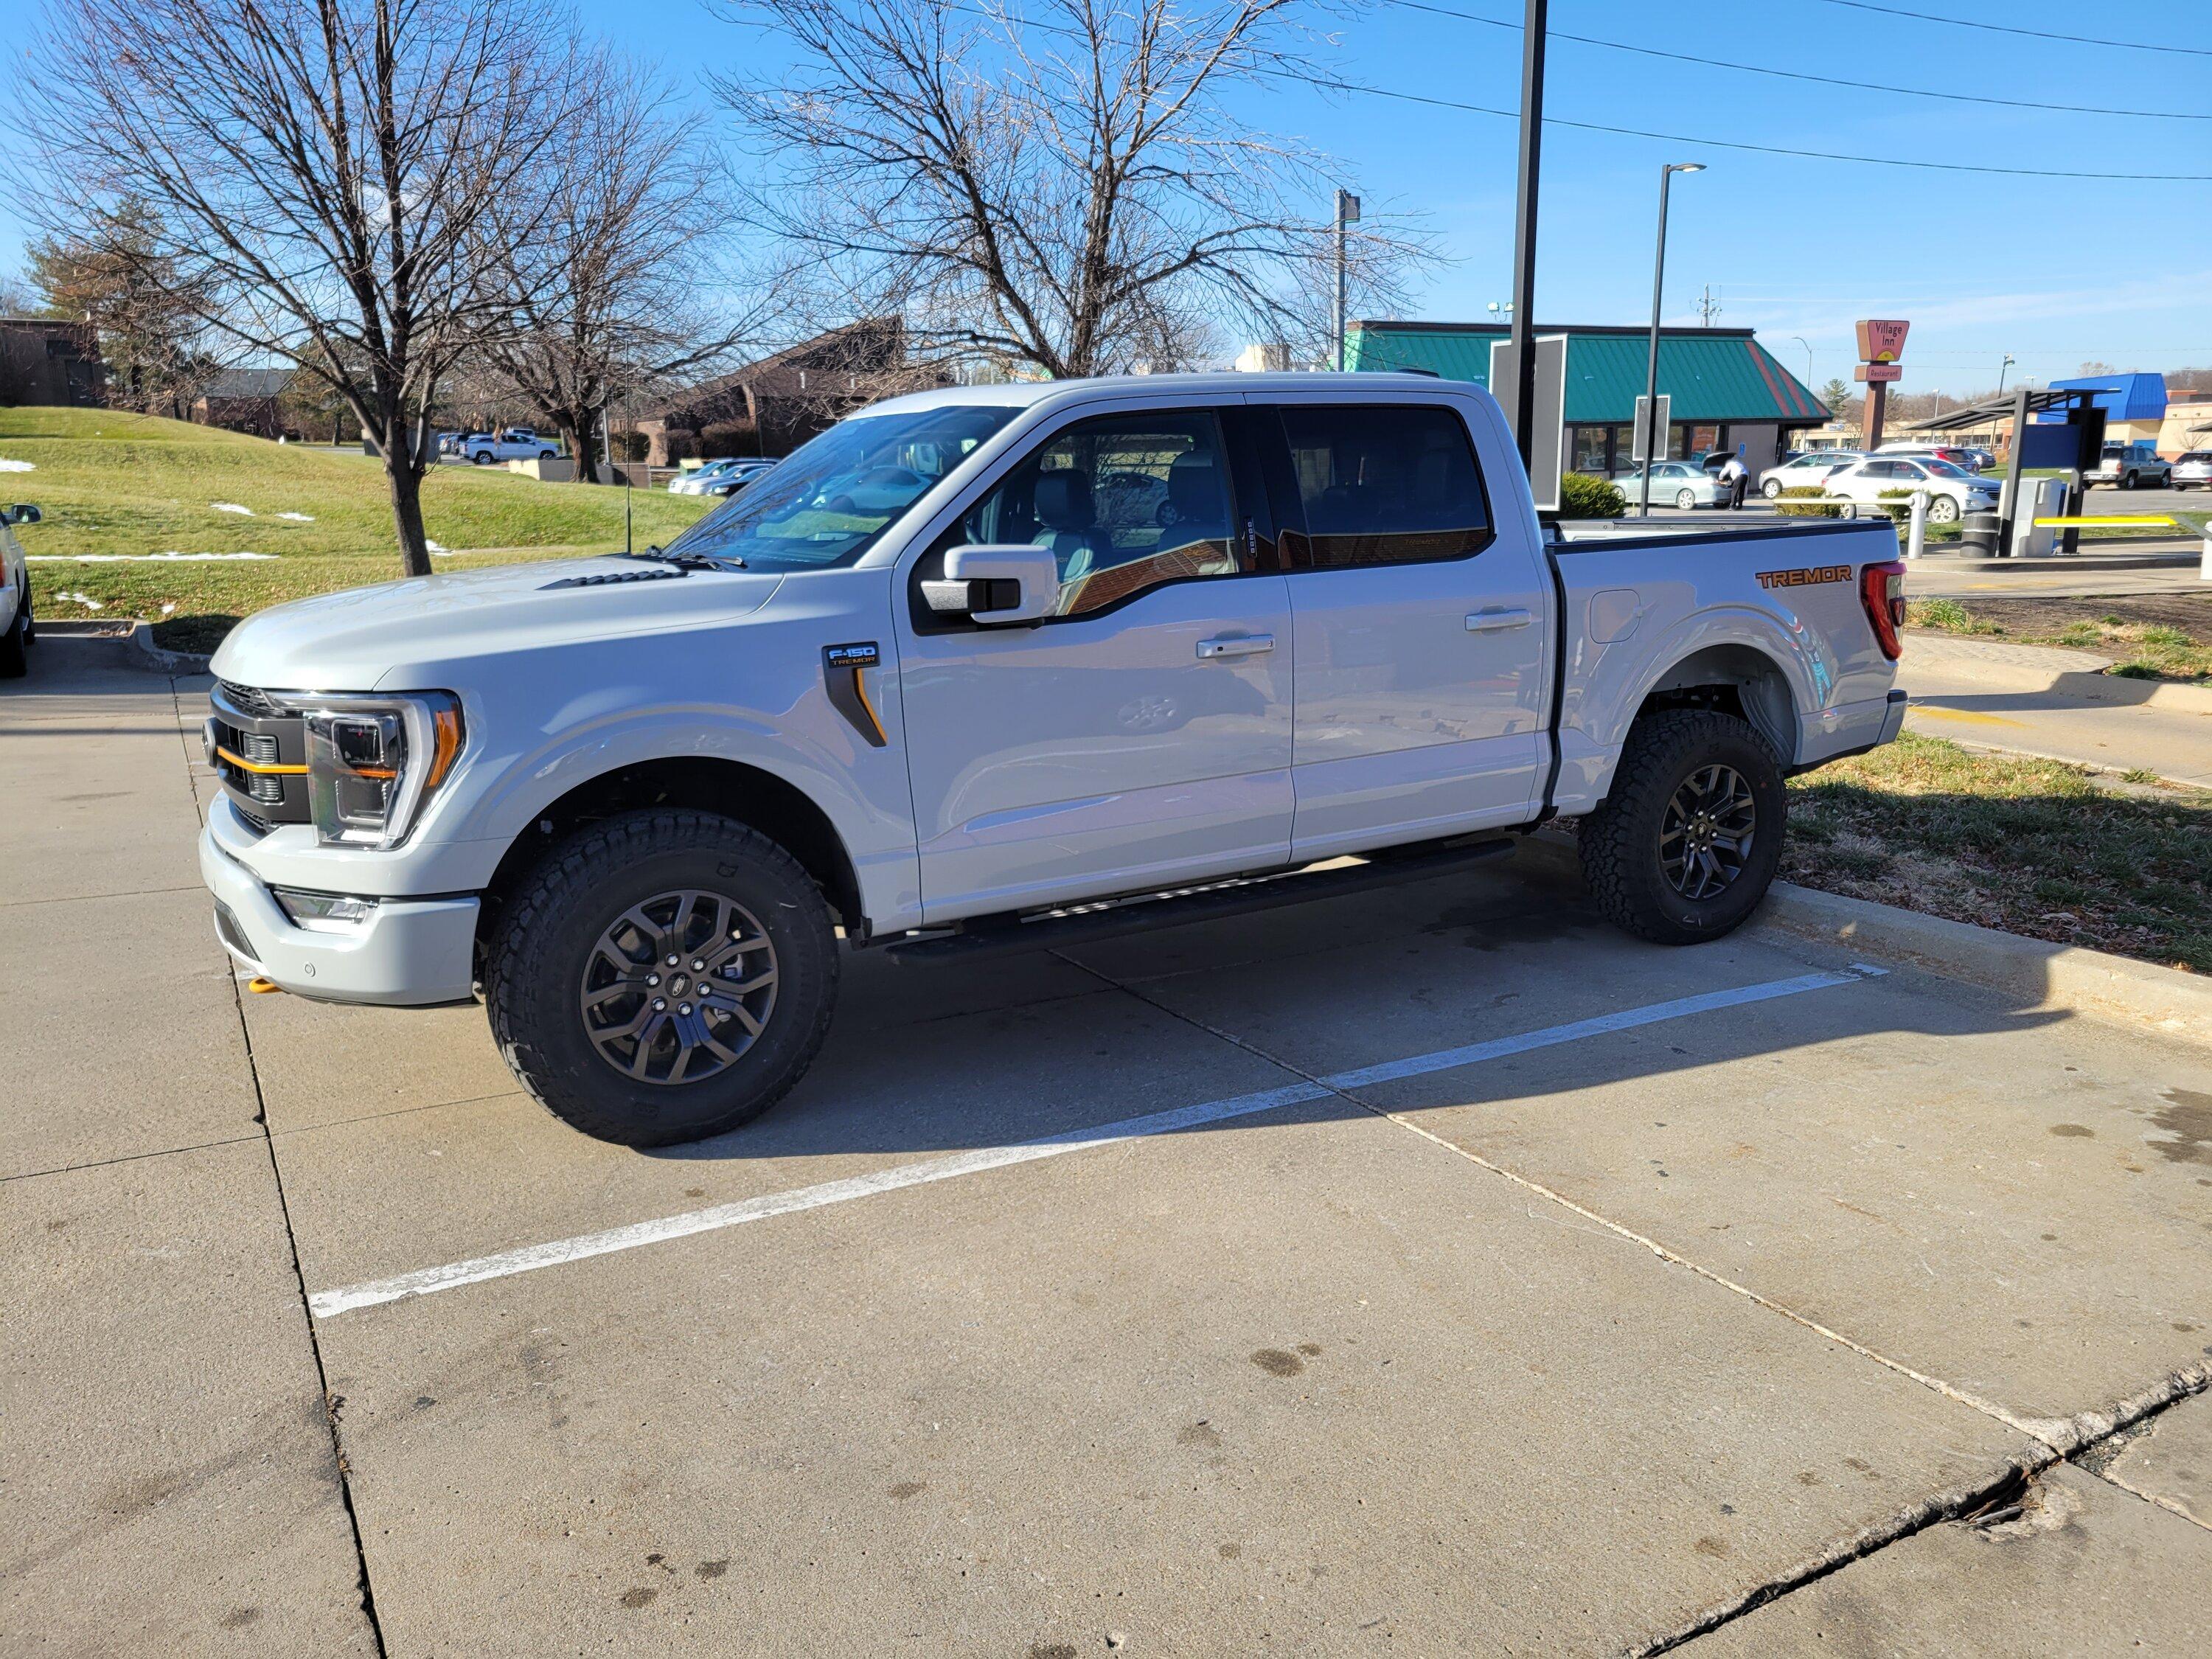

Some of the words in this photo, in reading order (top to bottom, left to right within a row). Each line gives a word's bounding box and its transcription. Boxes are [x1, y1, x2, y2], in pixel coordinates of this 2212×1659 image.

[1875, 321, 1902, 338] Village
[1882, 335, 1895, 346] Inn
[1871, 369, 1898, 378] Restaurant
[1755, 565, 1853, 588] TREMOR
[829, 646, 876, 659] F-150
[831, 657, 875, 666] TREMOR
